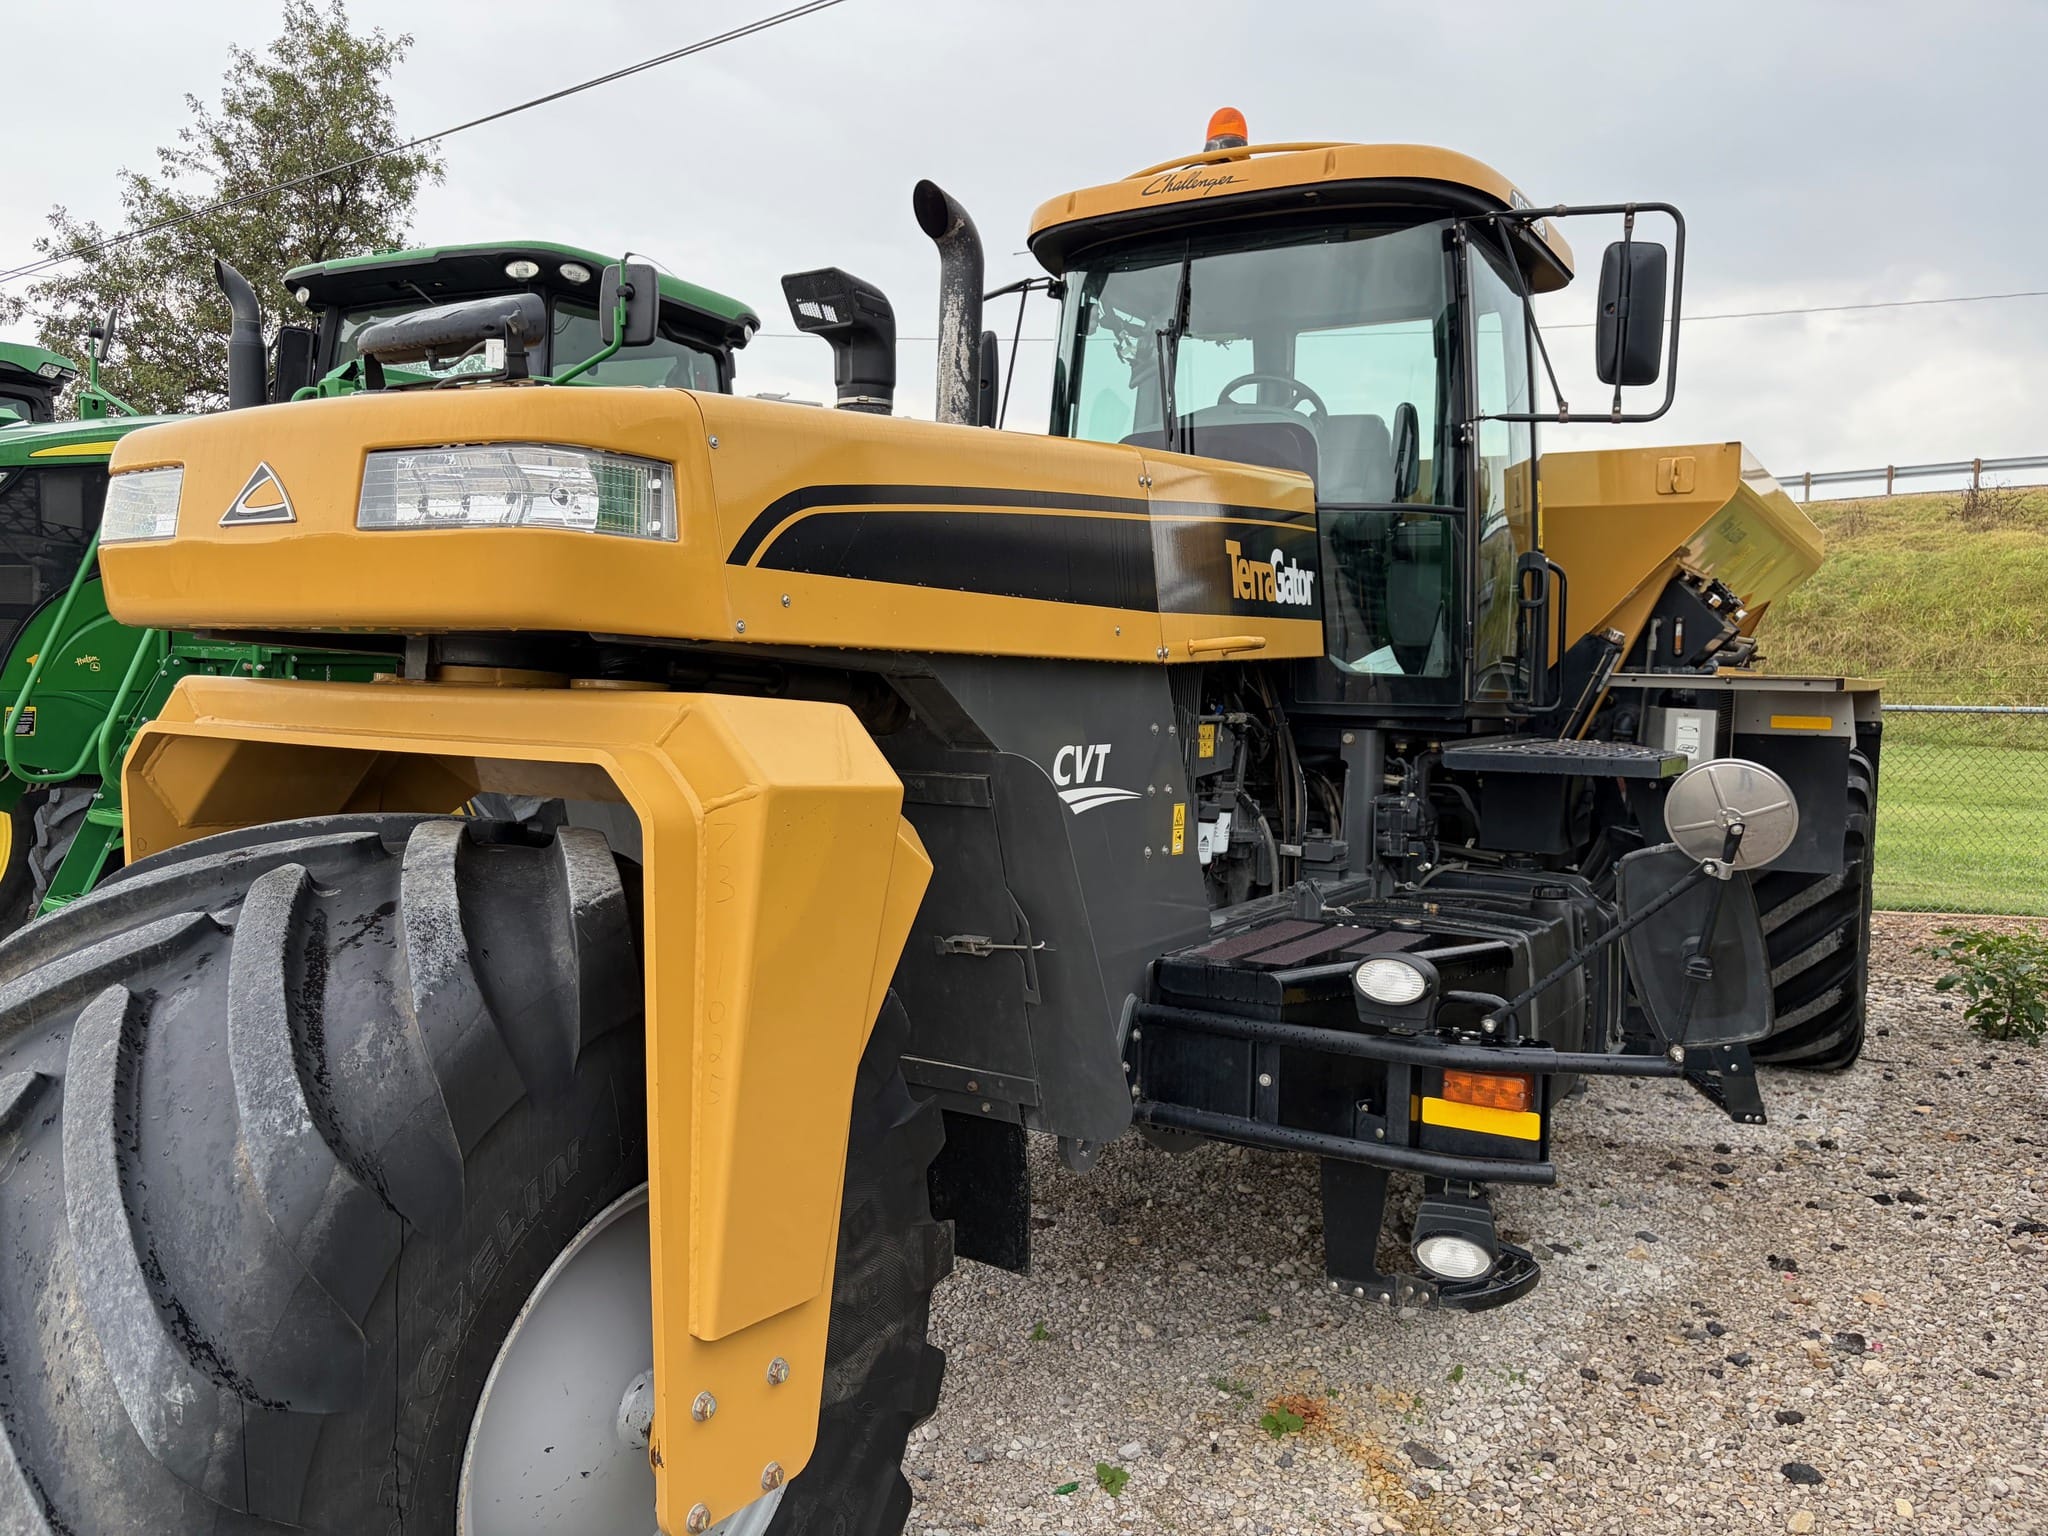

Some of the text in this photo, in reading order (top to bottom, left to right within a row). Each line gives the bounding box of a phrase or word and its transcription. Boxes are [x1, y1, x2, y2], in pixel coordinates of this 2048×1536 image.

[1141, 171, 1248, 196] Challenger
[1225, 539, 1315, 606] TerraGator
[1053, 743, 1112, 786] CVT
